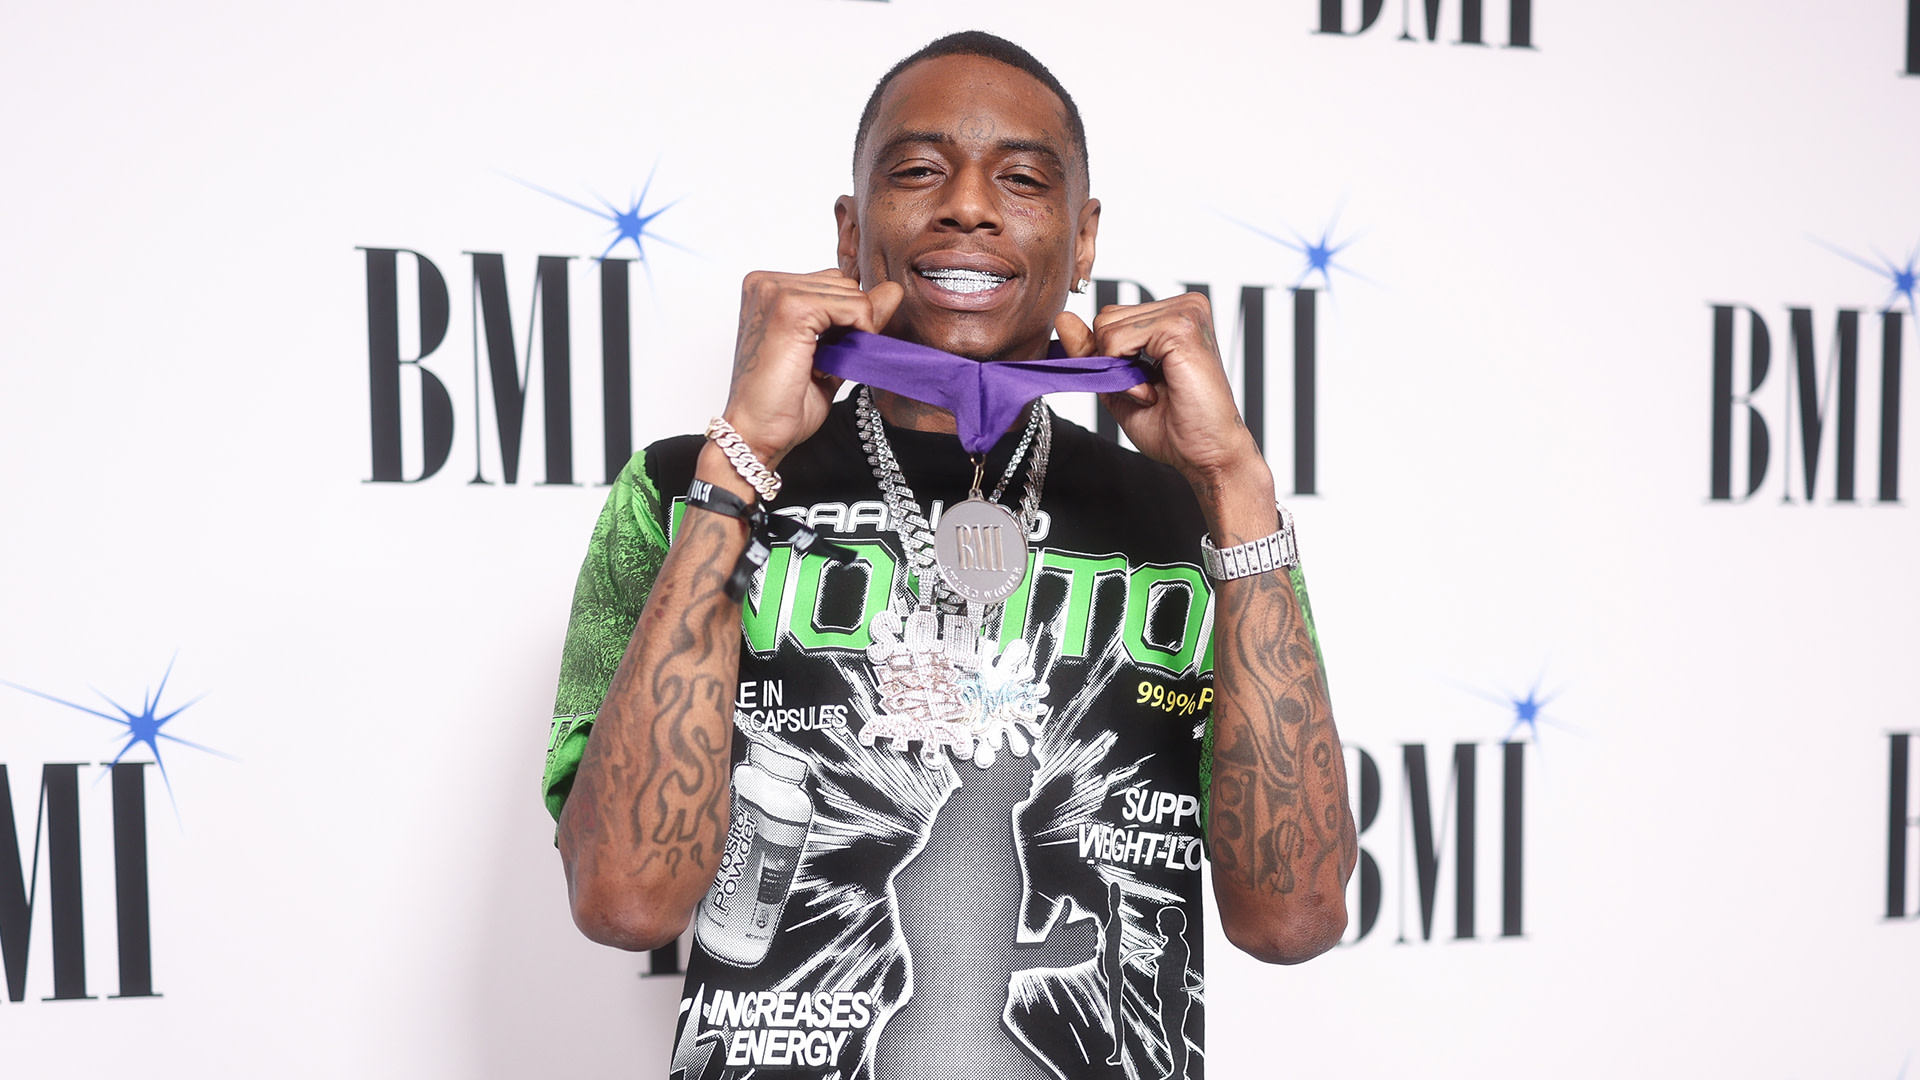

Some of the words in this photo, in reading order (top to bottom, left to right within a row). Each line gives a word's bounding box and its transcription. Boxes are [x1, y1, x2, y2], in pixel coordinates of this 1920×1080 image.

[354, 245, 640, 487] BMI
[1703, 300, 1912, 507] BMI
[955, 523, 1008, 572] BMI
[763, 679, 783, 708] IN
[1136, 681, 1196, 716] 99.9%
[1197, 687, 1214, 711] P
[750, 705, 849, 732] CAPSULES
[1122, 787, 1202, 828] SUPP
[713, 814, 758, 914] Powder
[706, 989, 873, 1029] INCREASES
[725, 1029, 851, 1067] ENERGY
